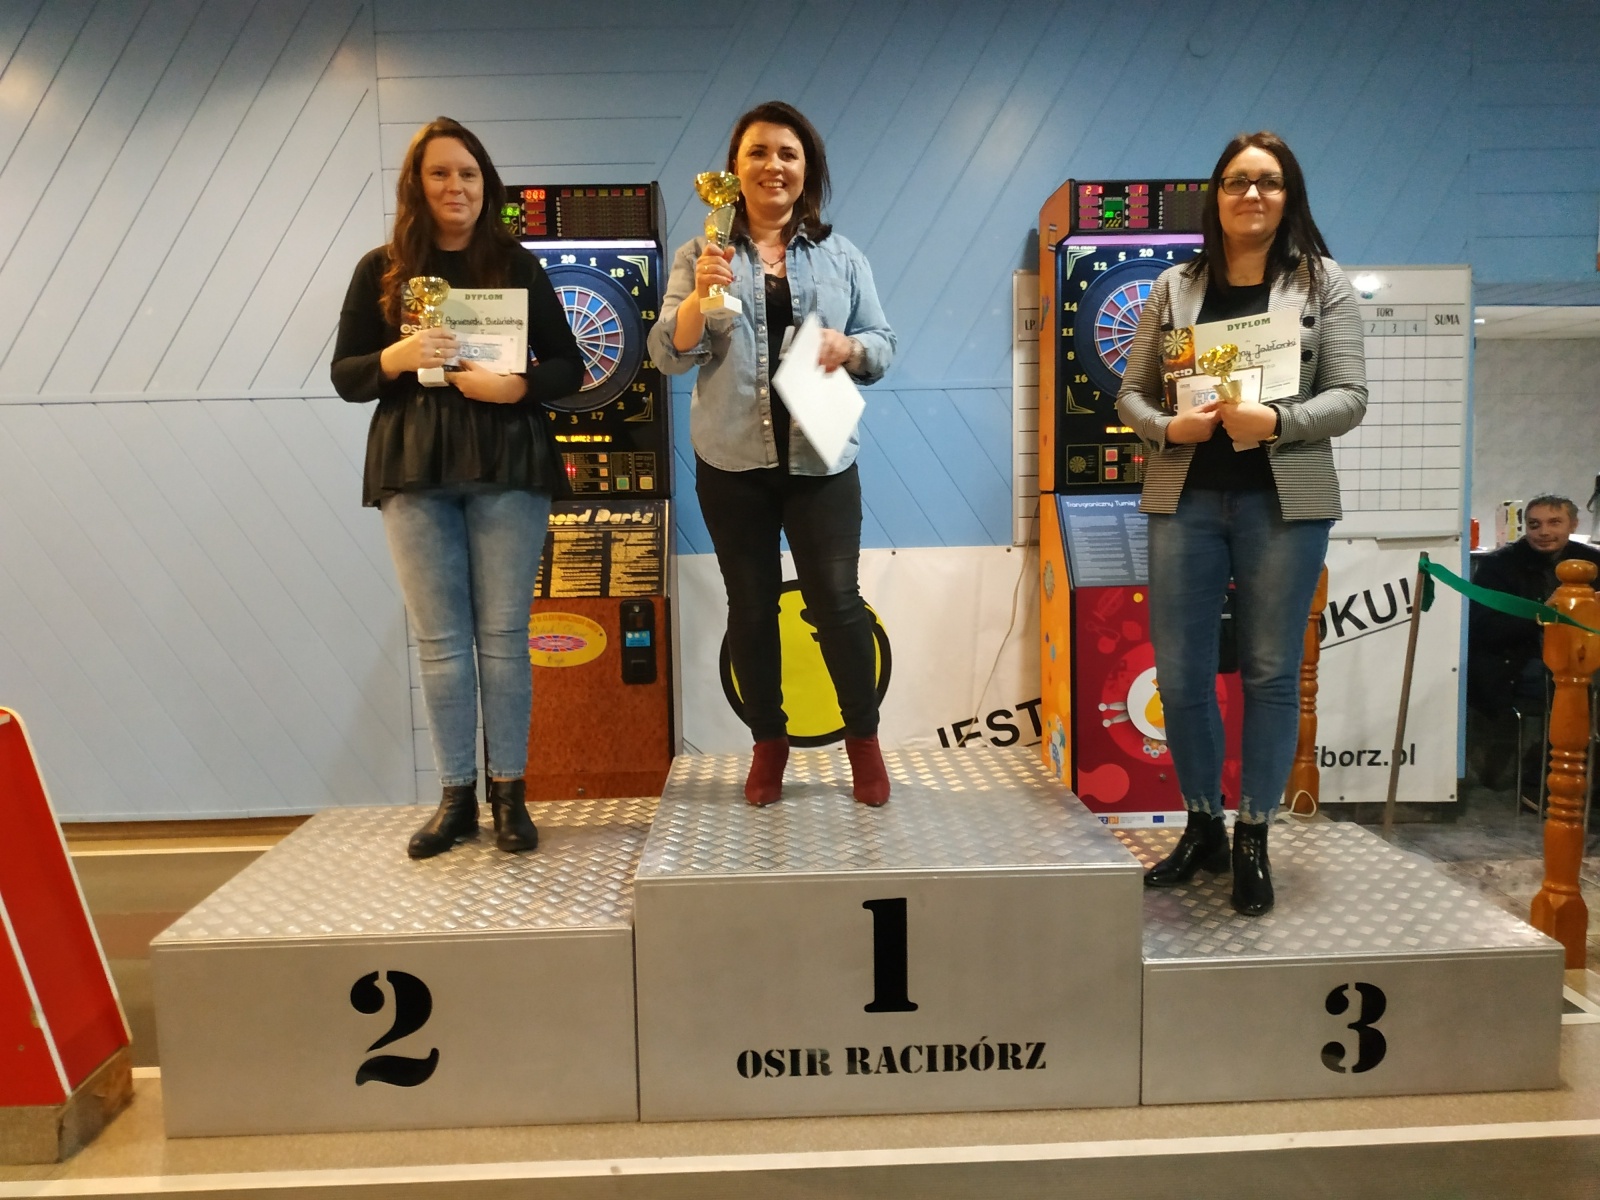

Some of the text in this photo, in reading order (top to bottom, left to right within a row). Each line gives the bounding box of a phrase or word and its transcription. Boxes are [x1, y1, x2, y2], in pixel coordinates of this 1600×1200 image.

[1118, 252, 1126, 261] 5
[1139, 248, 1154, 257] 20
[1166, 251, 1174, 260] 1
[560, 254, 577, 264] 20
[589, 257, 597, 267] 1
[1093, 262, 1108, 271] 12
[609, 268, 625, 278] 18
[1079, 281, 1088, 290] 9
[631, 286, 639, 296] 4
[465, 293, 503, 301] DYPLOM
[1063, 302, 1078, 312] 14
[641, 310, 656, 320] 13
[1434, 314, 1460, 326] SUMA
[1226, 317, 1271, 332] DYPLOM
[1392, 323, 1397, 333] 3
[1061, 328, 1074, 337] 11
[1067, 351, 1075, 360] 8
[1074, 374, 1088, 383] 16
[632, 383, 646, 392] 15
[1093, 391, 1101, 400] 7
[616, 401, 625, 410] 2
[570, 415, 579, 424] 3
[591, 411, 604, 421] 17
[594, 508, 654, 525] Darts
[1319, 577, 1414, 643] KU!
[862, 897, 919, 1013] 1
[350, 970, 440, 1087] 2
[1320, 981, 1387, 1073] 3
[736, 1035, 1047, 1079] OSIR RACIBÓRZ
